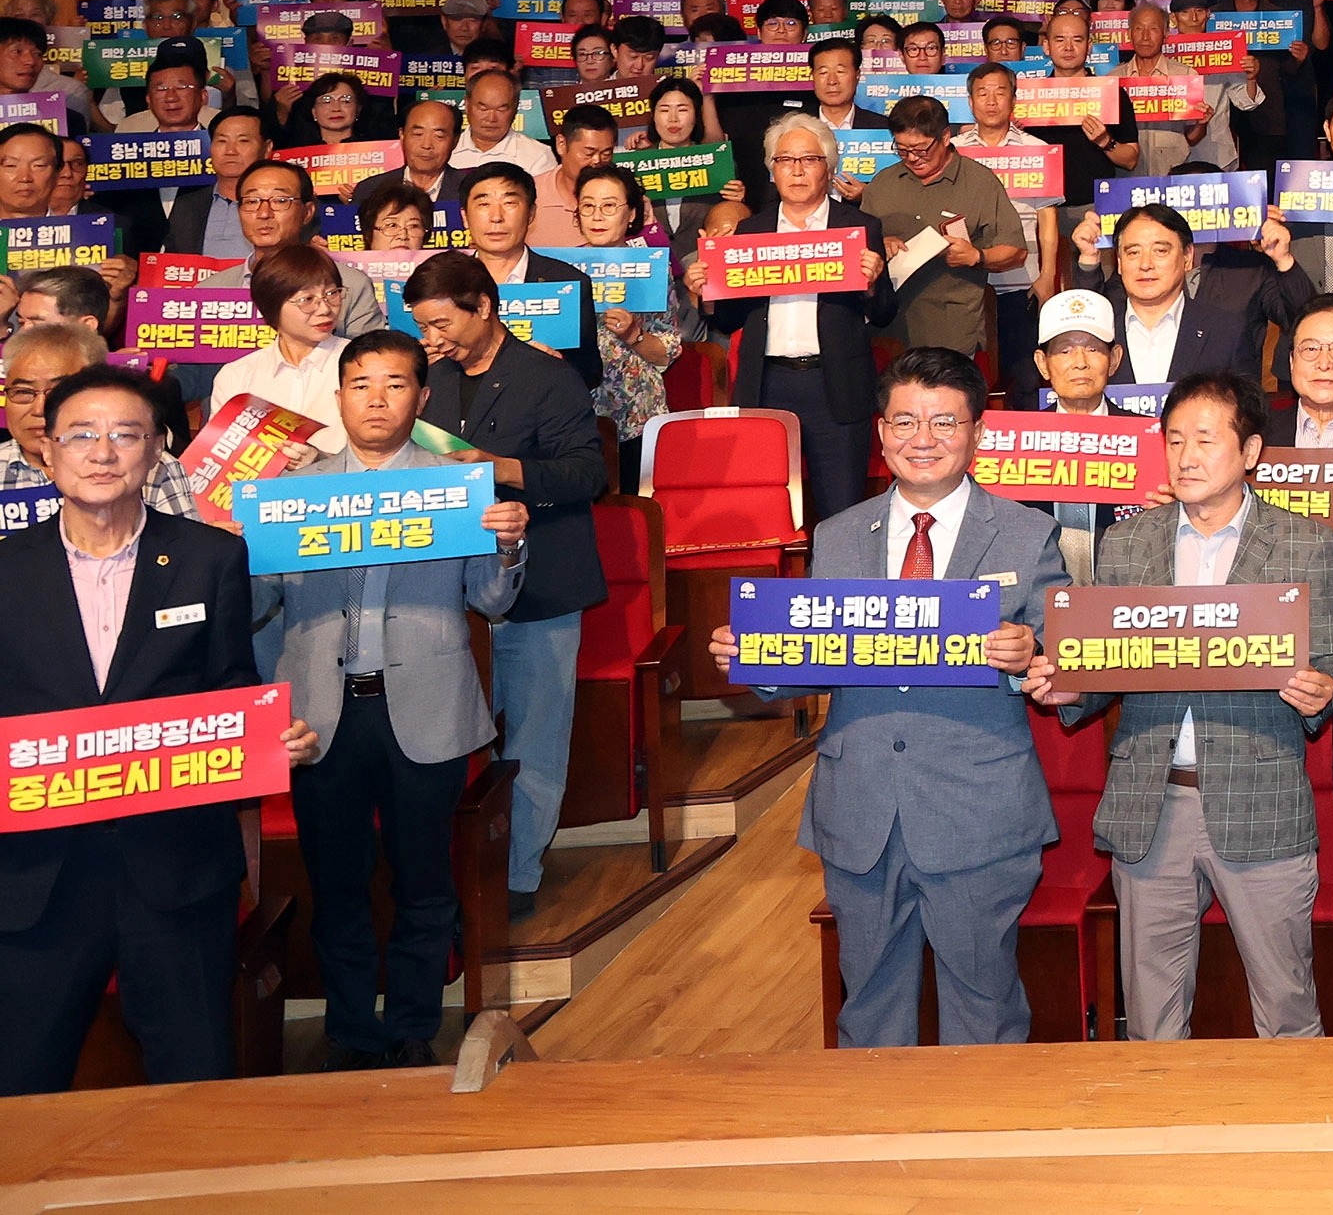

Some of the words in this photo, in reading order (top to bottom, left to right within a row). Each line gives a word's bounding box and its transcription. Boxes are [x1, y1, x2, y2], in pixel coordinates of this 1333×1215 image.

[725, 51, 746, 66] 충남
[748, 51, 783, 65] 관광의
[110, 141, 170, 160] 충남·태안
[174, 140, 202, 156] 함께
[150, 156, 203, 179] 통합본사
[723, 246, 754, 264] 충남
[756, 241, 843, 264] 미래항공산업
[725, 265, 803, 288] 중심도시
[806, 262, 845, 283] 태안
[162, 299, 195, 320] 충남
[201, 299, 253, 320] 관광의
[136, 325, 196, 349] 안면도
[1020, 427, 1138, 458] 미래항공산업
[972, 459, 1078, 489] 중심도시
[1082, 459, 1136, 490] 태안
[1255, 462, 1318, 485] 2027
[259, 493, 373, 523] 태안~서산
[379, 487, 468, 514] 고속도로
[298, 522, 363, 556] 조기
[370, 517, 433, 550] 착공
[789, 594, 888, 628] 충남·태안
[895, 596, 940, 628] 함께
[1112, 604, 1187, 629] 2027
[1193, 603, 1239, 628] 태안
[739, 633, 847, 666] 발전공기업
[853, 634, 940, 666] 통합본사
[944, 634, 988, 666] 유치
[1058, 636, 1201, 671] 유류피해극복
[1207, 634, 1295, 668] 20주년
[9, 735, 70, 769] 충남
[76, 711, 245, 759] 미래항공산업
[8, 757, 161, 812] 중심도시
[171, 746, 245, 788] 태안
